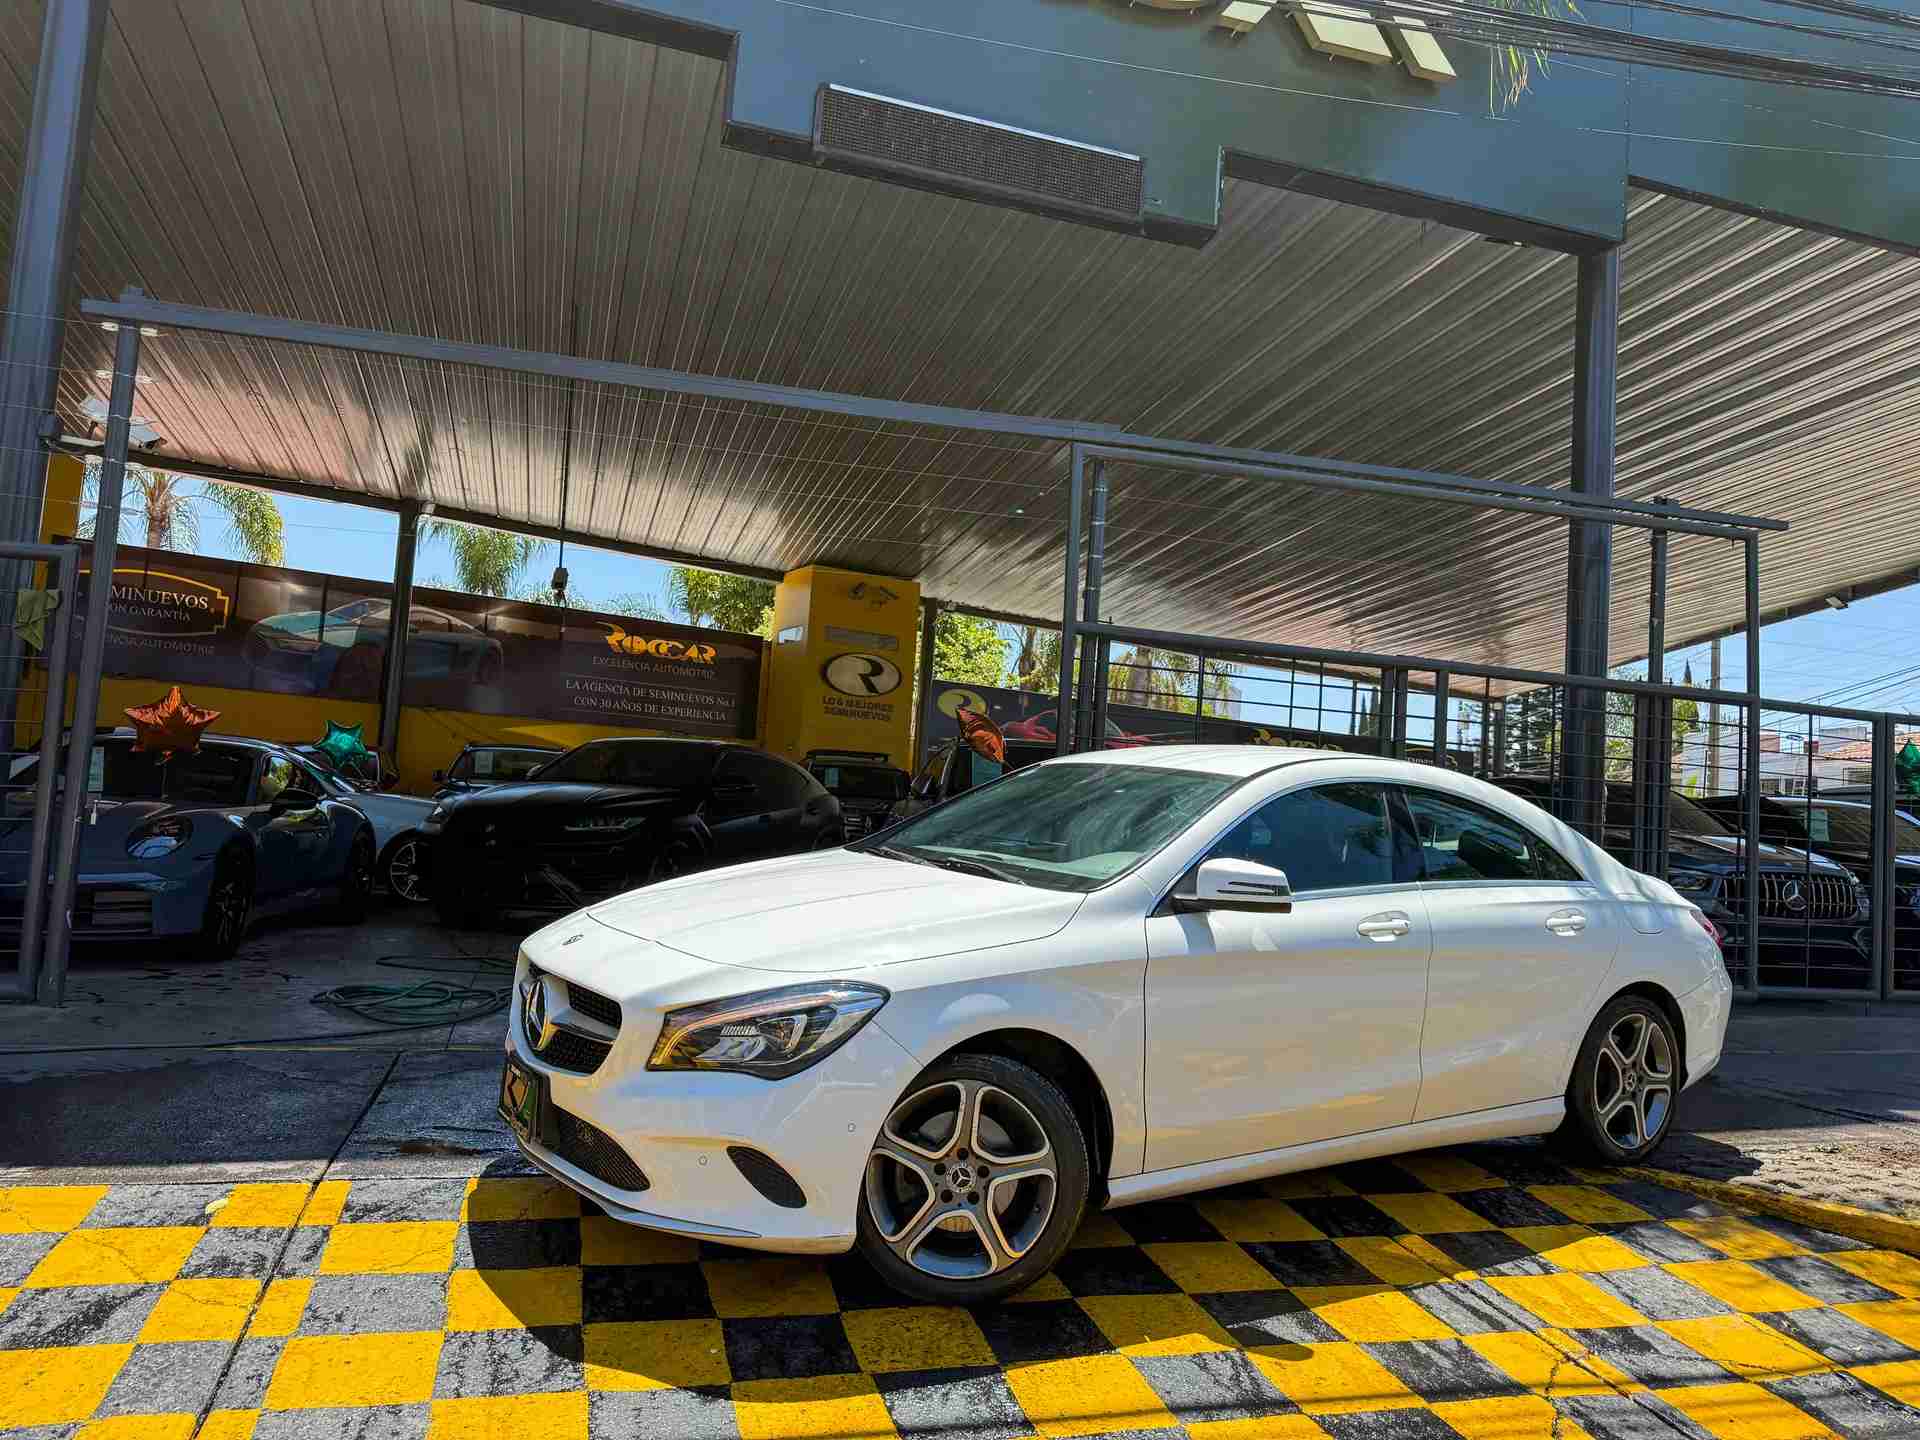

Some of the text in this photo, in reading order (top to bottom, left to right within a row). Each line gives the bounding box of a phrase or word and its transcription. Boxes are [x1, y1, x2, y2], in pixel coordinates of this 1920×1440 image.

[112, 585, 208, 609] MINUEVOS
[633, 687, 647, 697] DE
[649, 689, 715, 706] SEMINUEVOS
[574, 696, 597, 706] CON
[644, 703, 659, 714] DE
[661, 705, 727, 722] EXPERIENCIA
